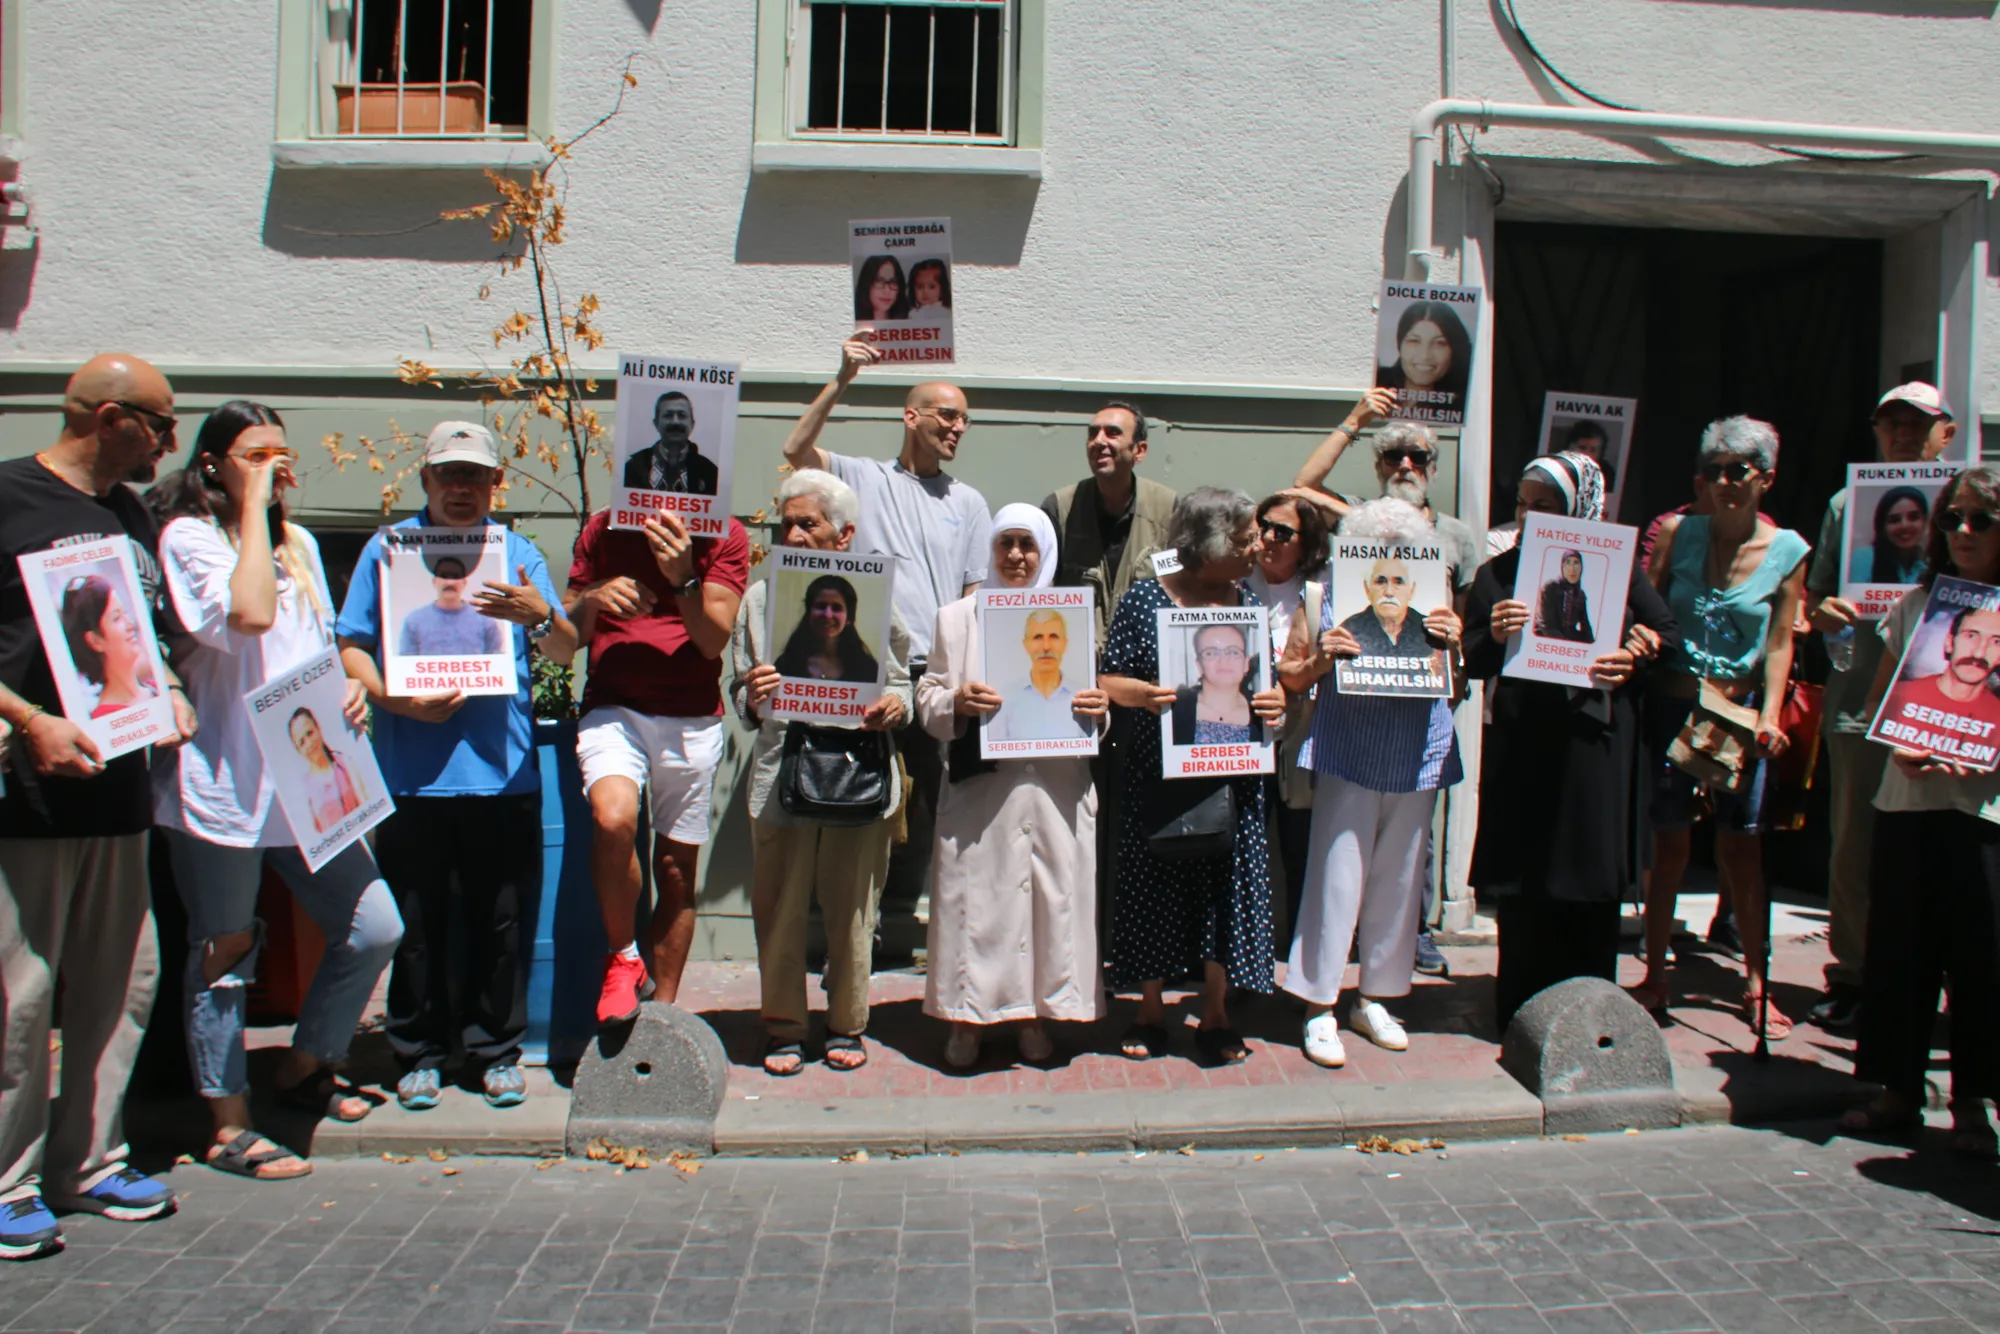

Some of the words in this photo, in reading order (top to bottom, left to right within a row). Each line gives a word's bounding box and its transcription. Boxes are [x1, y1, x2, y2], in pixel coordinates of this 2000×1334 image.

[1430, 290, 1476, 303] BOZAN
[869, 327, 941, 342] SERBEST
[876, 347, 952, 361] RAKILSIN
[623, 360, 645, 377] ALİ
[648, 363, 696, 381] OSMAN
[700, 366, 736, 385] KÖSE
[1555, 400, 1601, 415] HAVVA
[1604, 405, 1624, 416] AK
[1857, 468, 1905, 479] RUKEN
[1910, 467, 1958, 478] YILDIZ
[628, 492, 713, 513] SERBEST
[425, 532, 464, 544] TAHSİN
[466, 532, 503, 544] AKGÜN
[1536, 528, 1582, 544] HATİCE
[1586, 535, 1623, 550] YILDIZ
[1339, 545, 1388, 559] HASAN
[1393, 546, 1440, 560] ASLAN
[783, 552, 831, 569] HİYEM
[835, 559, 884, 574] YOLCU
[987, 592, 1026, 606] FEVZİ
[1028, 593, 1083, 605] ARSLAN
[1171, 612, 1208, 623] FATMA
[1210, 611, 1258, 622] TOKMAK
[1536, 642, 1588, 658] SERBEST
[415, 660, 492, 673] SERBEST
[1351, 655, 1432, 670] SERBEST
[405, 675, 504, 689] BIRAKILSIN
[1342, 671, 1444, 688] BIRAKILSIN
[783, 682, 859, 700] SERBEST
[771, 697, 867, 717] BIRAKILSIN
[1902, 702, 1996, 738] SERBEST
[988, 742, 1032, 752] SERBEST
[1035, 739, 1093, 750] BIRAKILSIN
[1880, 719, 1997, 762] BIRAKILSIN
[1190, 745, 1251, 758] SERBEST
[1182, 759, 1260, 773] BIRAKILSIN
